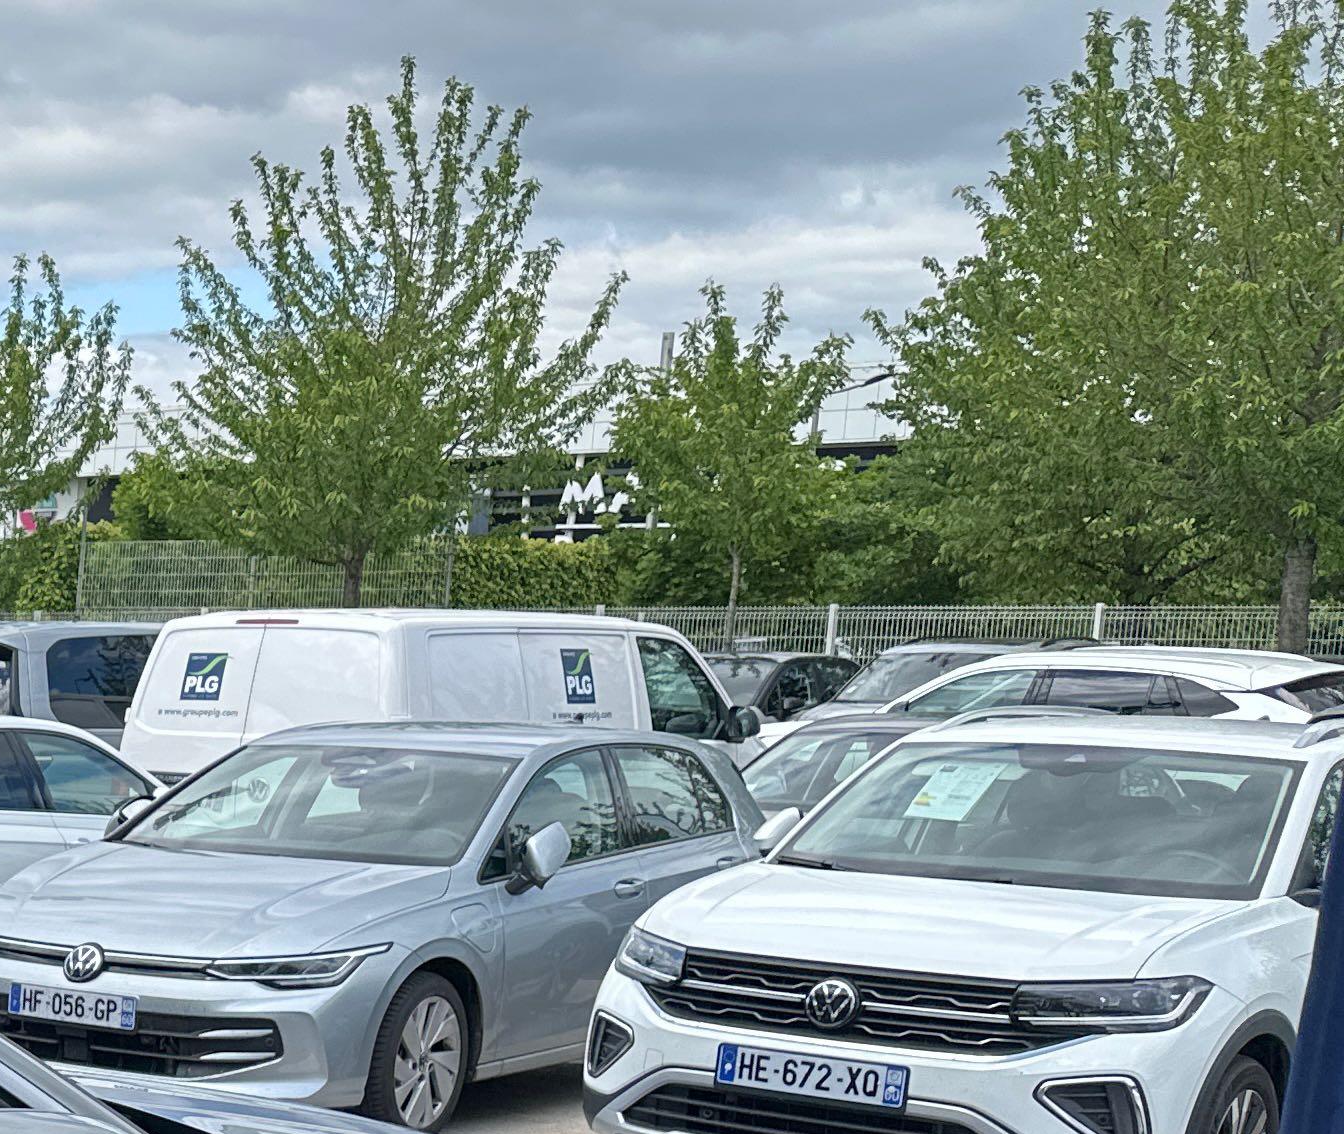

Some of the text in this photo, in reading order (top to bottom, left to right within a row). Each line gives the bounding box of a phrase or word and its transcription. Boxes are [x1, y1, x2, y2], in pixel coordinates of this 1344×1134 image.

[183, 675, 219, 694] PLG
[566, 675, 593, 696] PLG
[22, 988, 118, 1022] HF-056-GP
[738, 1052, 880, 1098] HE-672-XQ
